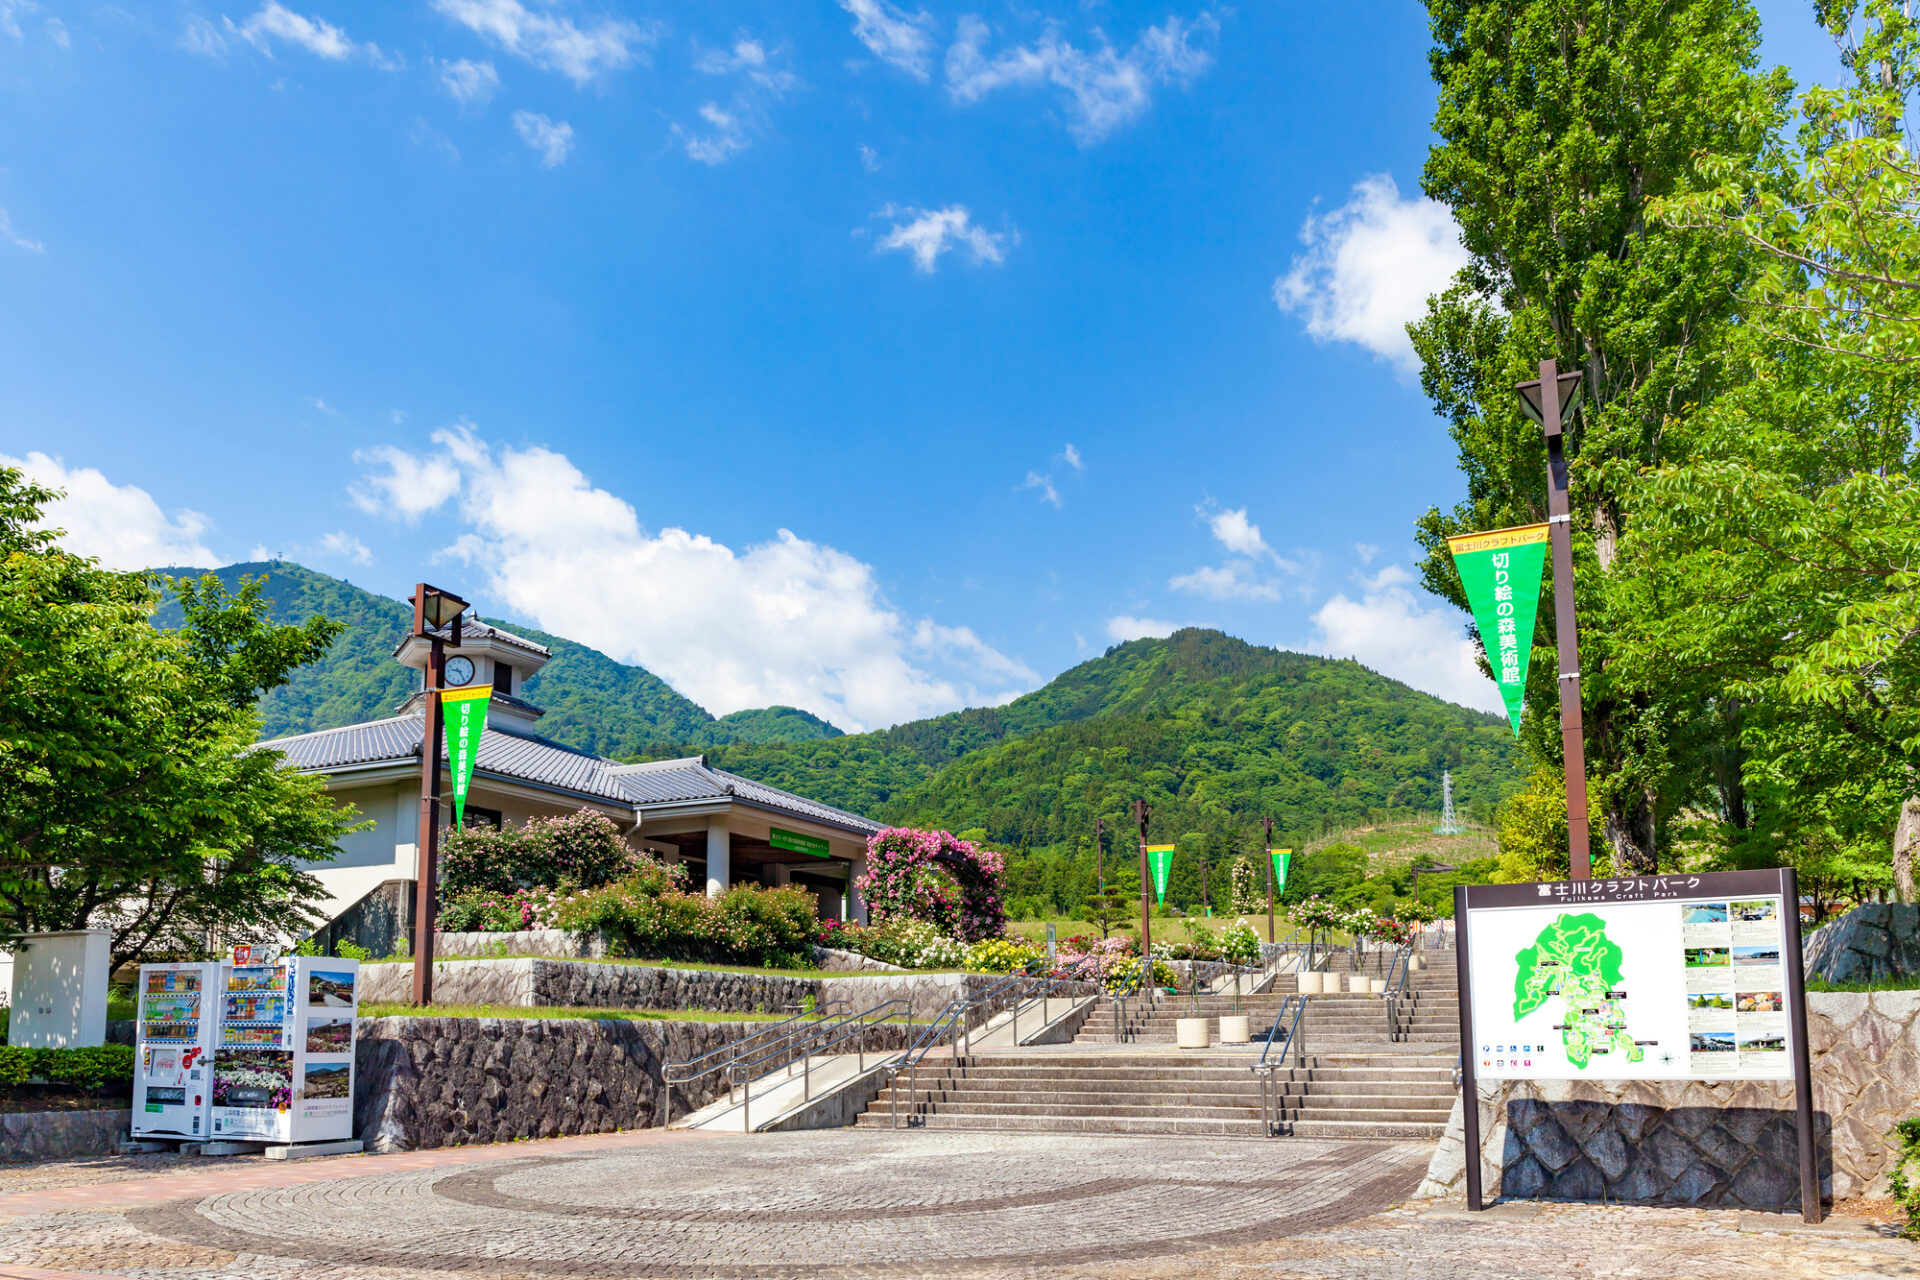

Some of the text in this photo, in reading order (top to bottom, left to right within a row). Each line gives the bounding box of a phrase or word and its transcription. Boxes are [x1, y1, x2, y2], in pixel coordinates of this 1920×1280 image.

[1455, 532, 1545, 552] 富士川クラフトパーク
[1492, 552, 1520, 684] 切り絵の森美術館
[457, 703, 471, 796] 切り絵の森美術館
[1537, 876, 1701, 897] 富士川クラフトパーク
[1561, 890, 1678, 903] Fujikawa Craft Park
